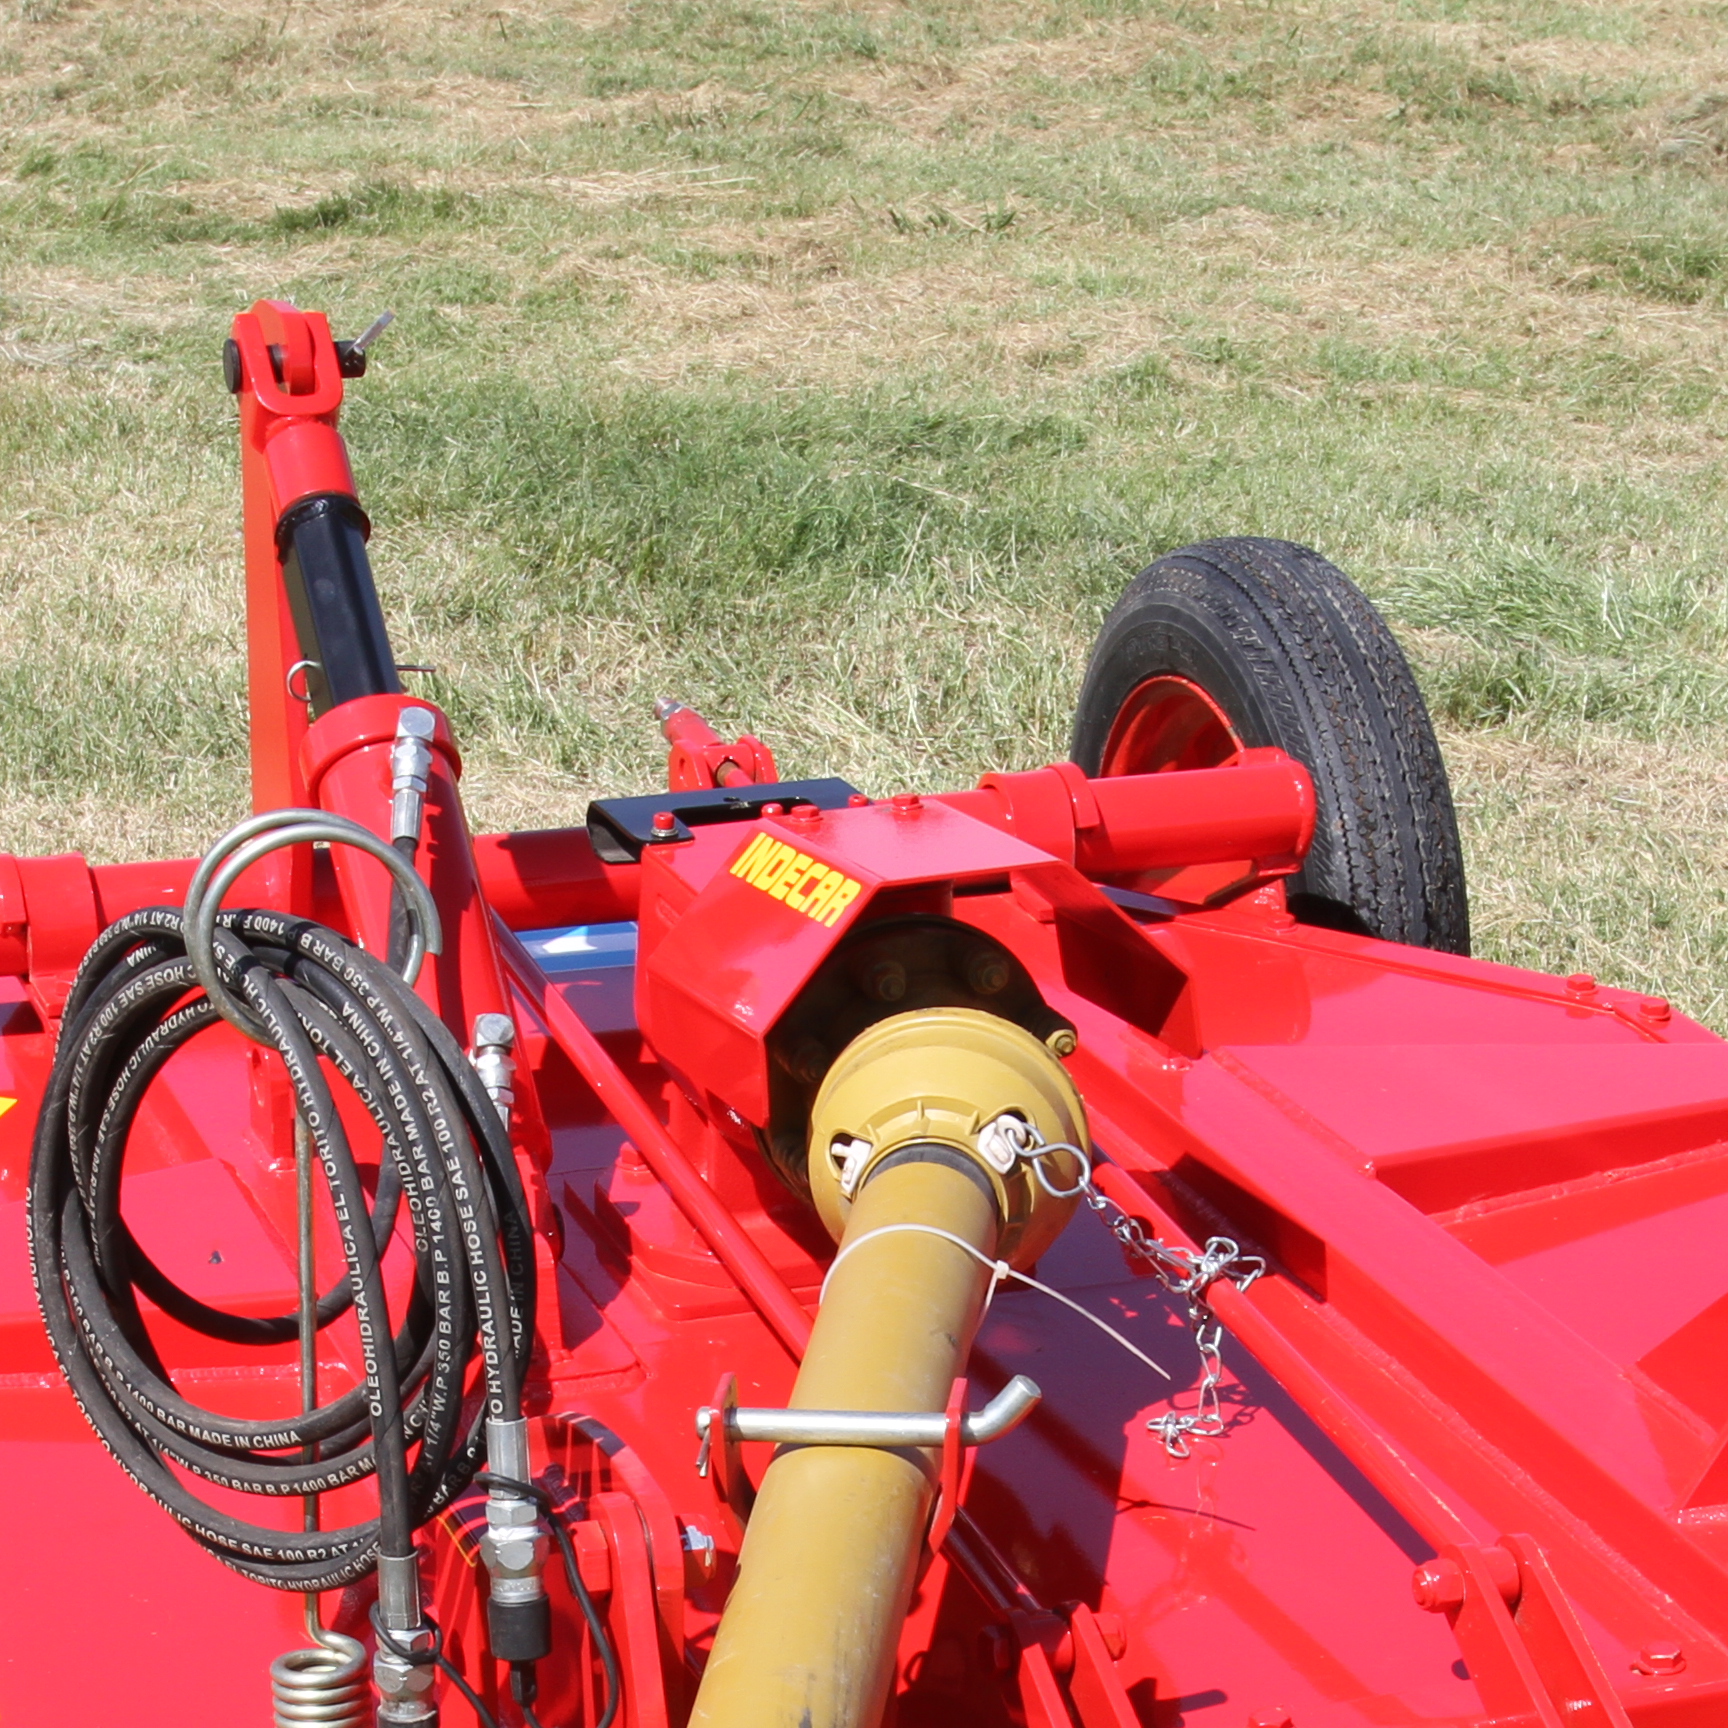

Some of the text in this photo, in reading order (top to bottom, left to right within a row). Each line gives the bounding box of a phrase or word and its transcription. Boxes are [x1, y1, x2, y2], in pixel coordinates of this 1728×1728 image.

[729, 832, 862, 928] INDECAR
[253, 915, 286, 935] 1400
[309, 938, 347, 971] BAR
[115, 980, 147, 1009] SAE
[143, 965, 185, 990] HOSE
[341, 965, 372, 996] 350
[97, 1001, 122, 1028] 100
[338, 999, 382, 1058] CHINA
[86, 1021, 106, 1045] R2
[125, 1004, 196, 1071] HYDRAULIC
[76, 1041, 96, 1066] AT
[251, 996, 315, 1109] HYDRAULIC
[327, 1048, 354, 1076] EL
[374, 1056, 395, 1080] IN
[105, 1065, 134, 1112] HOSE
[406, 1059, 430, 1089] AT
[386, 1079, 421, 1141] MADE
[420, 1087, 442, 1116] R2
[305, 1109, 341, 1190] TORITO
[432, 1116, 456, 1153] 100
[347, 1072, 429, 1252] OLEOHIDRAULICA
[410, 1143, 435, 1191] BAR
[445, 1155, 469, 1201] SAE
[333, 1192, 349, 1221] EL
[425, 1195, 445, 1243] 1400
[459, 1203, 484, 1266] HOSE
[434, 1248, 450, 1284] B.P
[341, 1224, 383, 1417] OLEOHIDRAULICA
[438, 1290, 451, 1334] BAR
[469, 1269, 504, 1394] HYDRAULIC
[437, 1339, 450, 1373] 350
[153, 1407, 189, 1433] BAR
[184, 1424, 234, 1447] MADE
[233, 1435, 250, 1448] IN
[252, 1427, 302, 1449] CHINA
[228, 1478, 264, 1495] BAR
[292, 1476, 326, 1496] 1400
[325, 1463, 360, 1487] BAR
[238, 1542, 272, 1558] SAE
[328, 1542, 349, 1558] AT
